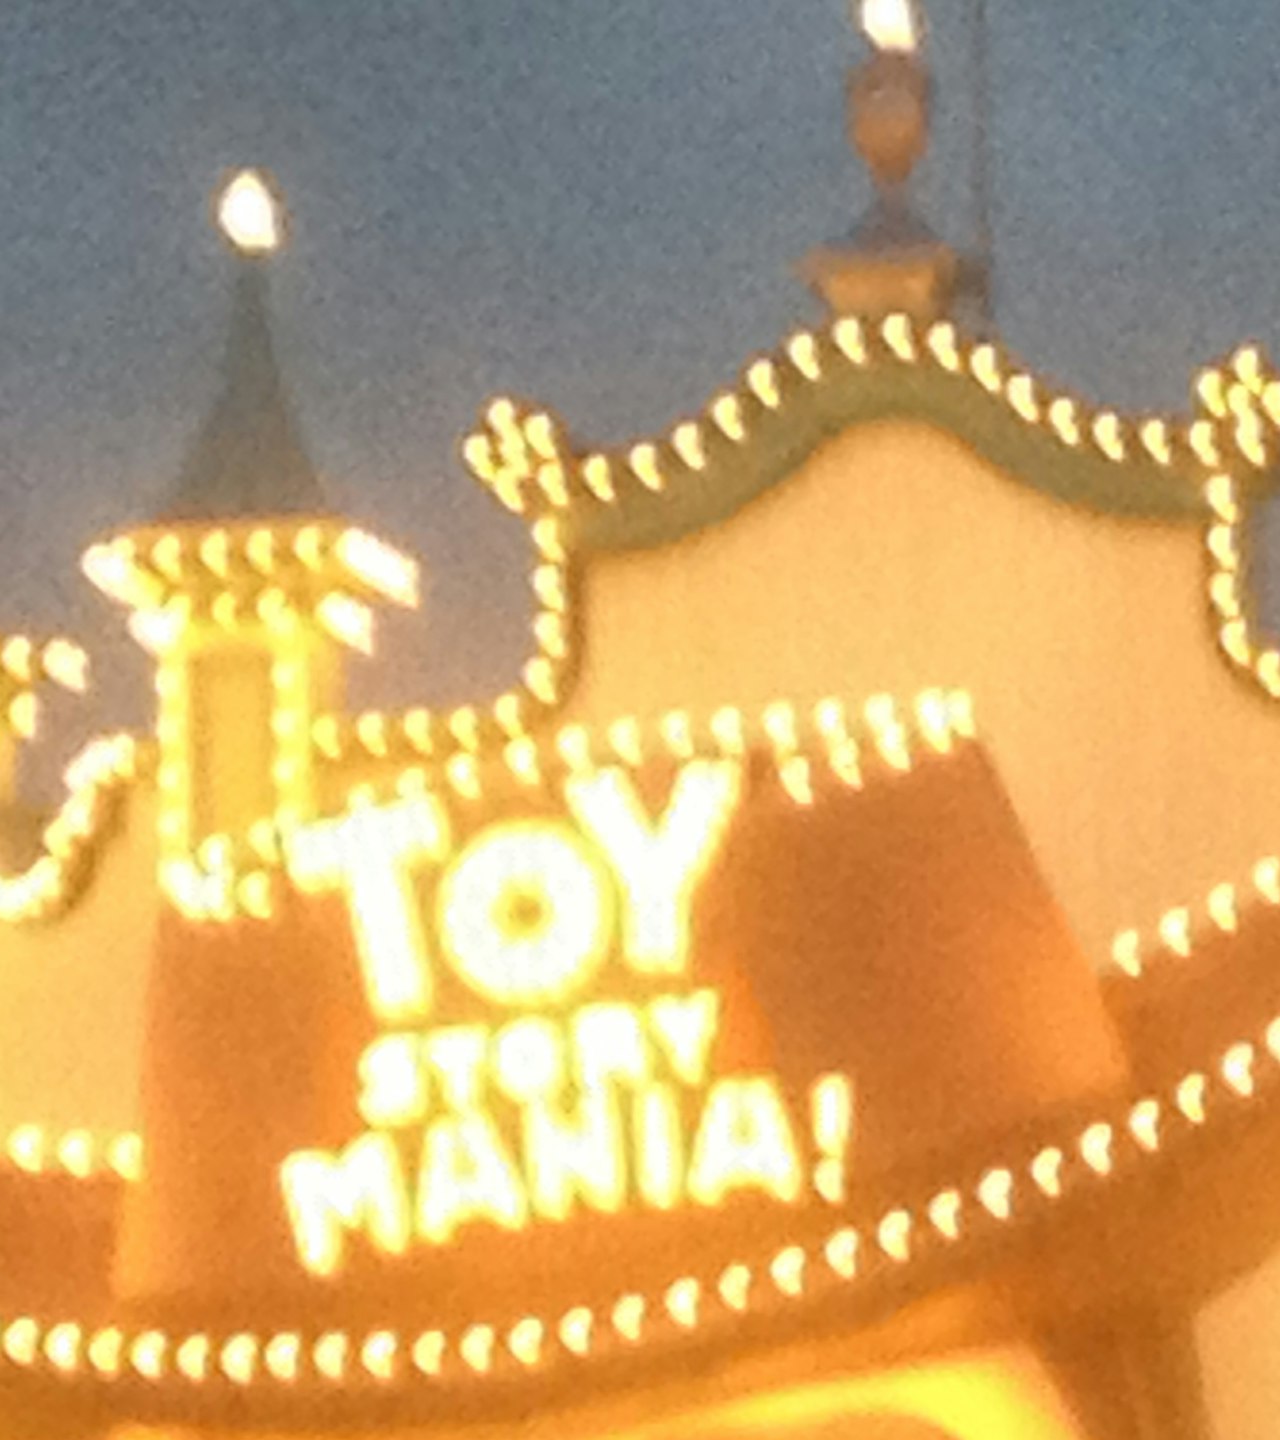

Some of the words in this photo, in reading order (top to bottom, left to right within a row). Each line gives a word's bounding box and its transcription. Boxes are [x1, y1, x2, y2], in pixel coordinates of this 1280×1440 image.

[283, 758, 743, 1021] TOY
[358, 989, 720, 1127] STORY
[281, 1073, 852, 1276] MANIA!
